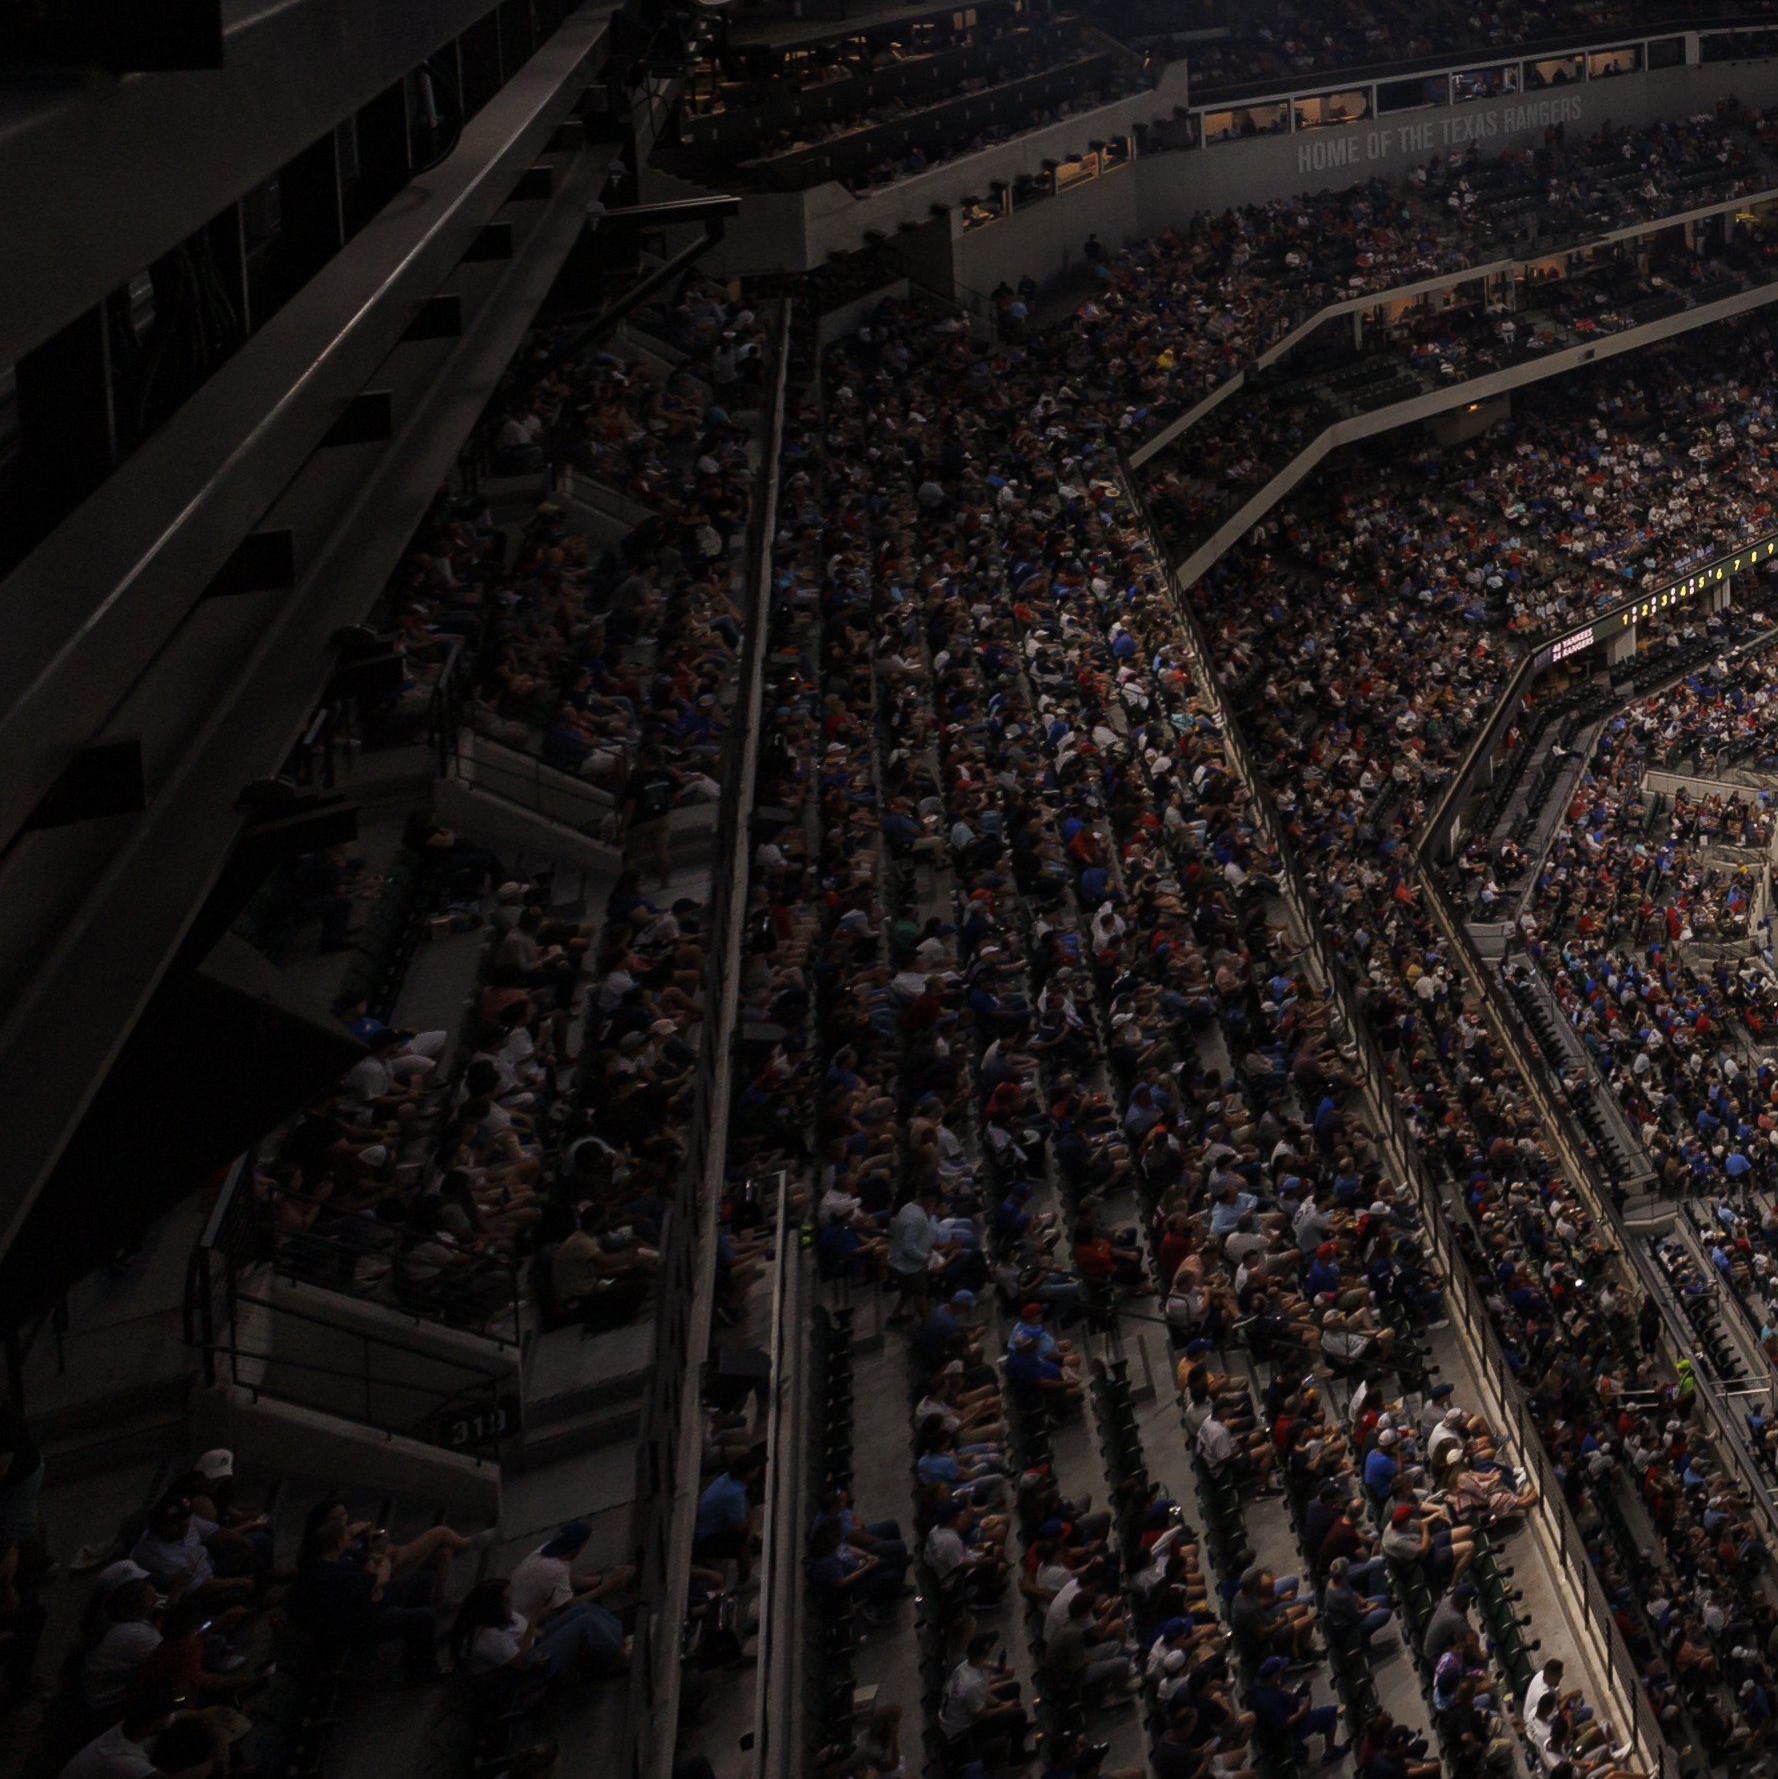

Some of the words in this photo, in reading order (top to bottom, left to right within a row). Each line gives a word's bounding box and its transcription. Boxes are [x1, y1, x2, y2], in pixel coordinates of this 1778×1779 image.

[1298, 135, 1360, 173] HOME
[1367, 130, 1394, 160] OF
[1397, 122, 1434, 154] THE
[1440, 110, 1498, 146] TEXAS
[1503, 95, 1582, 133] RANGERS
[1562, 627, 1593, 649] YANKEES
[1562, 637, 1595, 658] RANGERS
